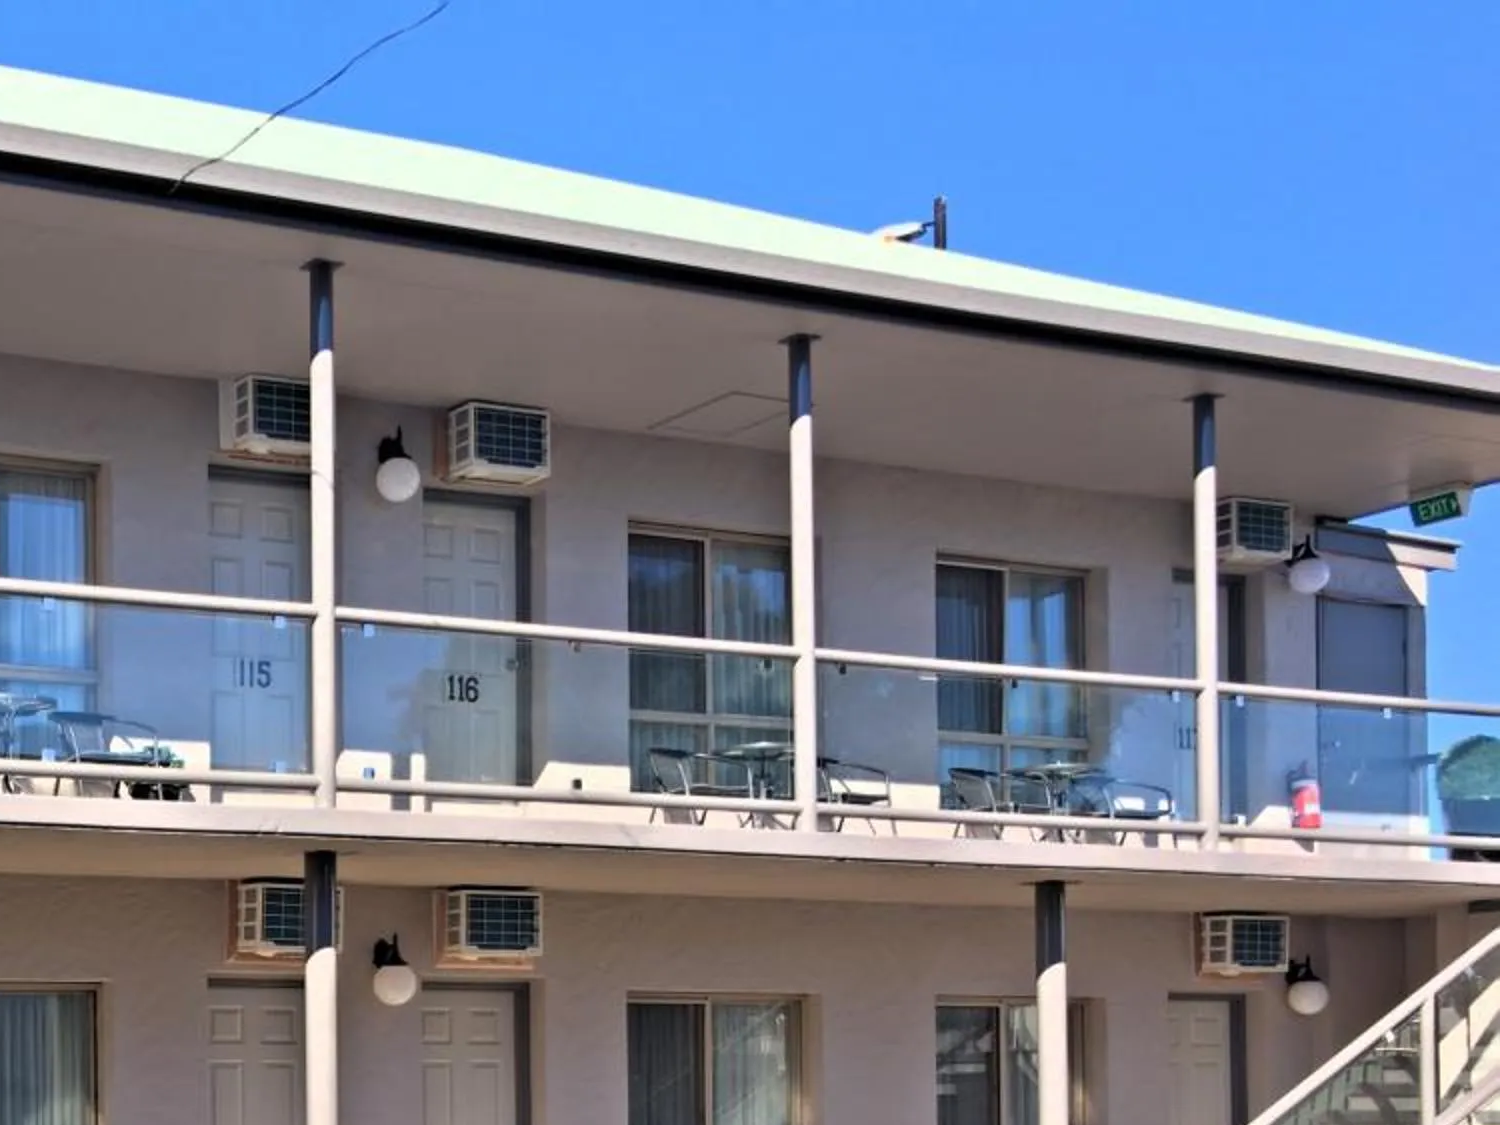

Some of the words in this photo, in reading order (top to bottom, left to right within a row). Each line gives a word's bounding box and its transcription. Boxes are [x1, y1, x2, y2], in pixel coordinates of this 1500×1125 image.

[239, 659, 271, 689] 115
[448, 675, 479, 703] 116
[1178, 726, 1198, 751] 11
